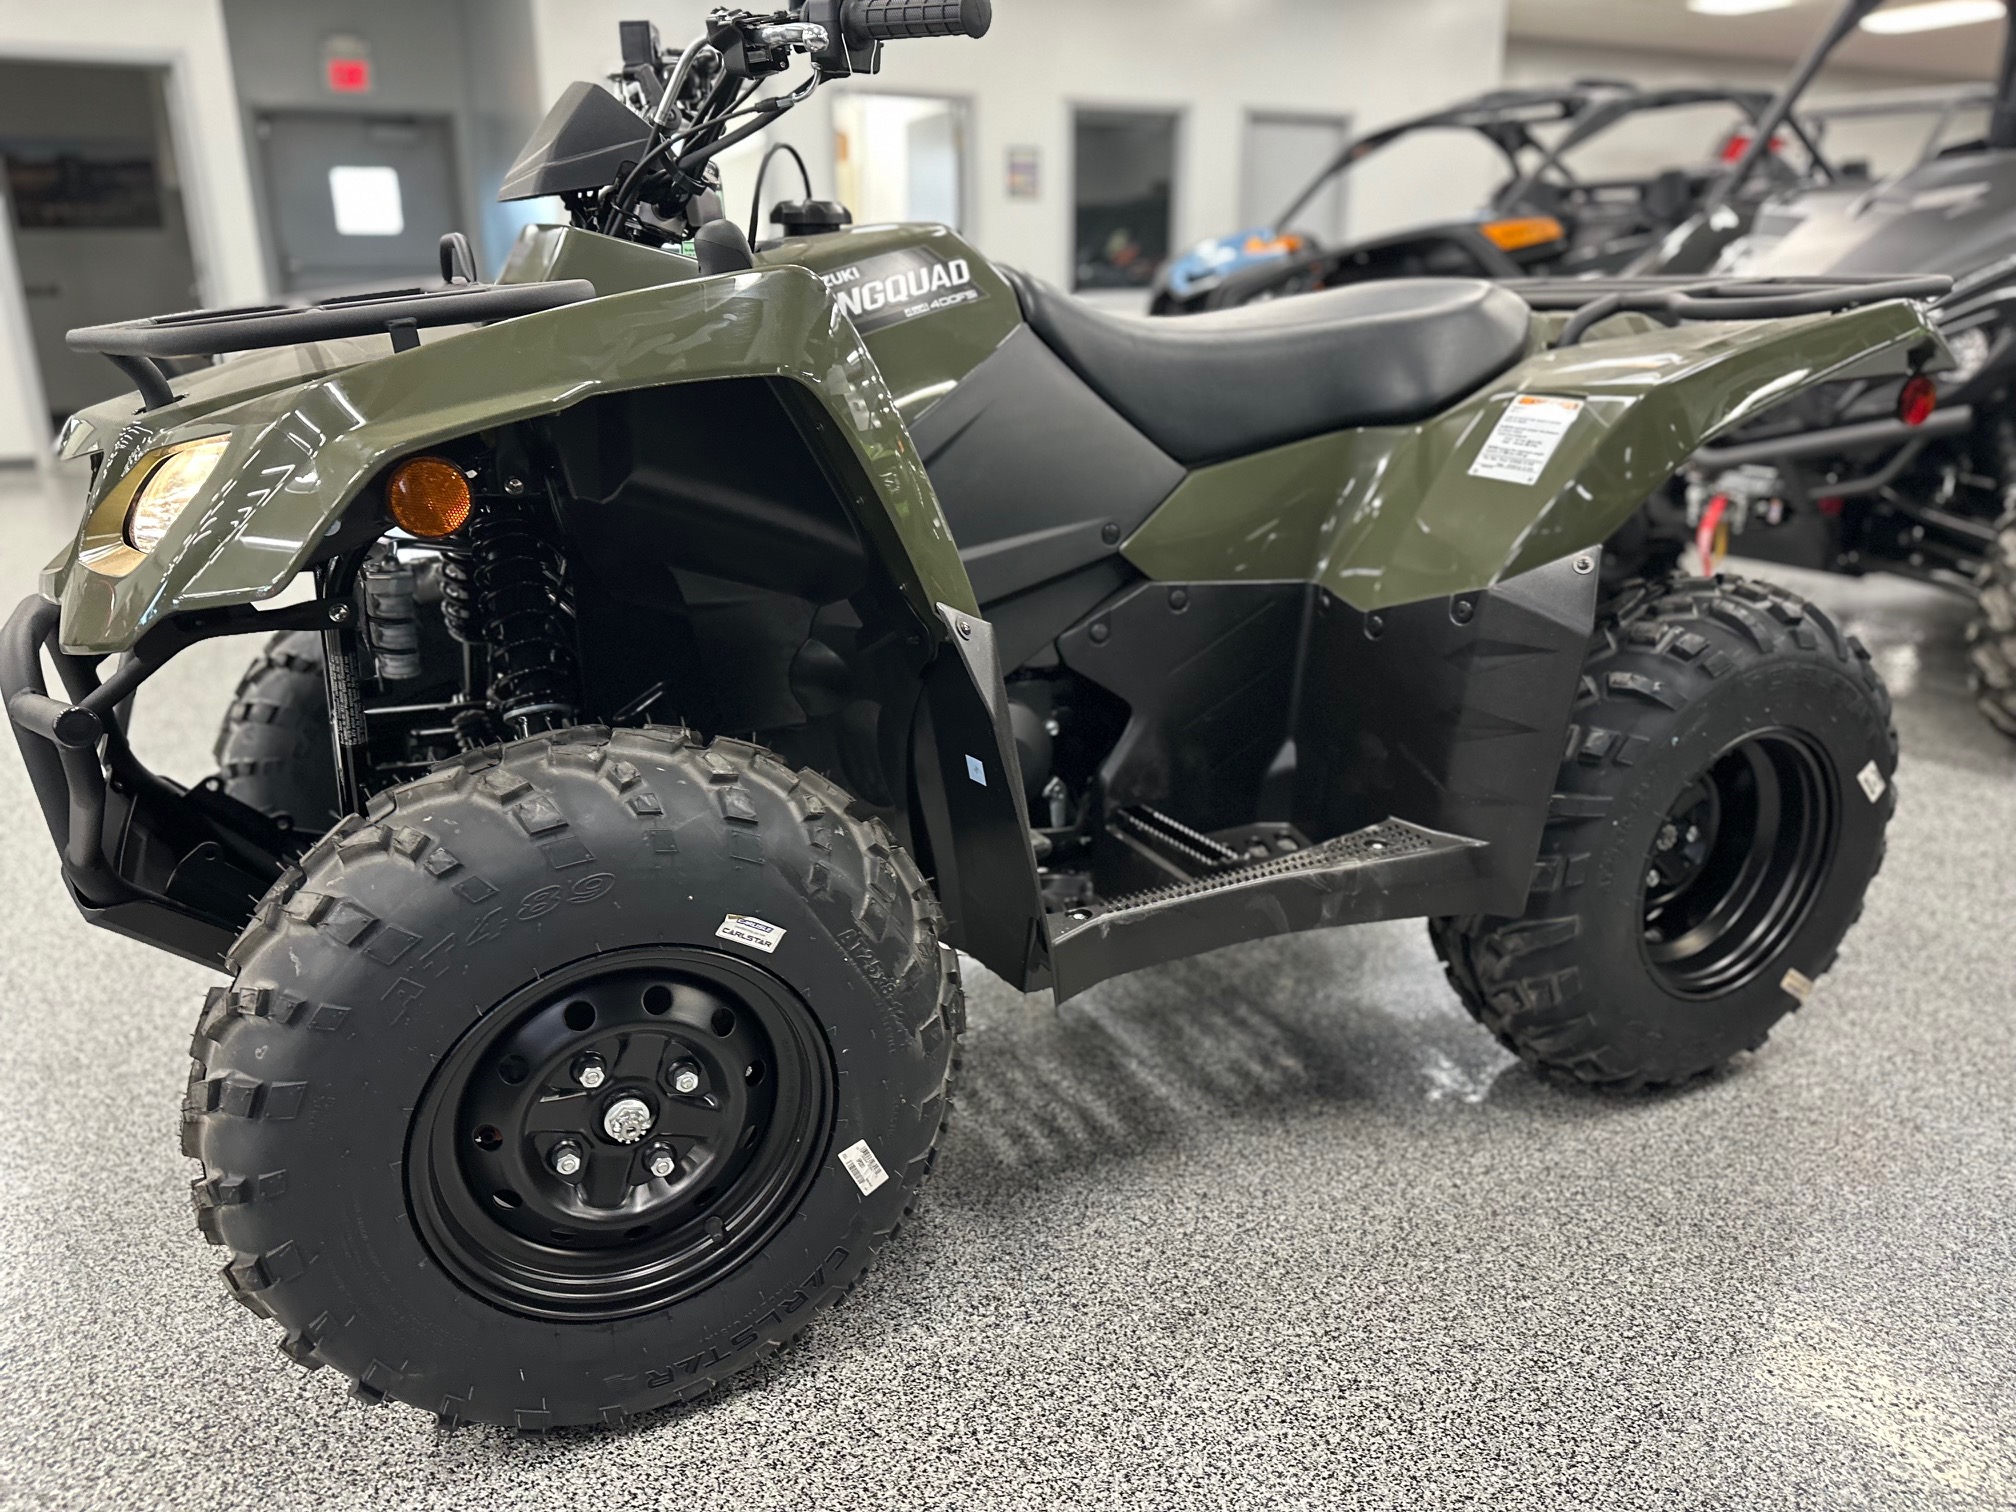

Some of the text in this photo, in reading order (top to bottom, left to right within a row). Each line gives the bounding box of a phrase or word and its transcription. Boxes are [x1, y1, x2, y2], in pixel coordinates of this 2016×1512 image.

[822, 266, 860, 287] ZUKI
[837, 258, 970, 316] NGQUAD
[722, 927, 773, 947] CARLSTAR
[645, 1245, 850, 1390] CARLSTAR
